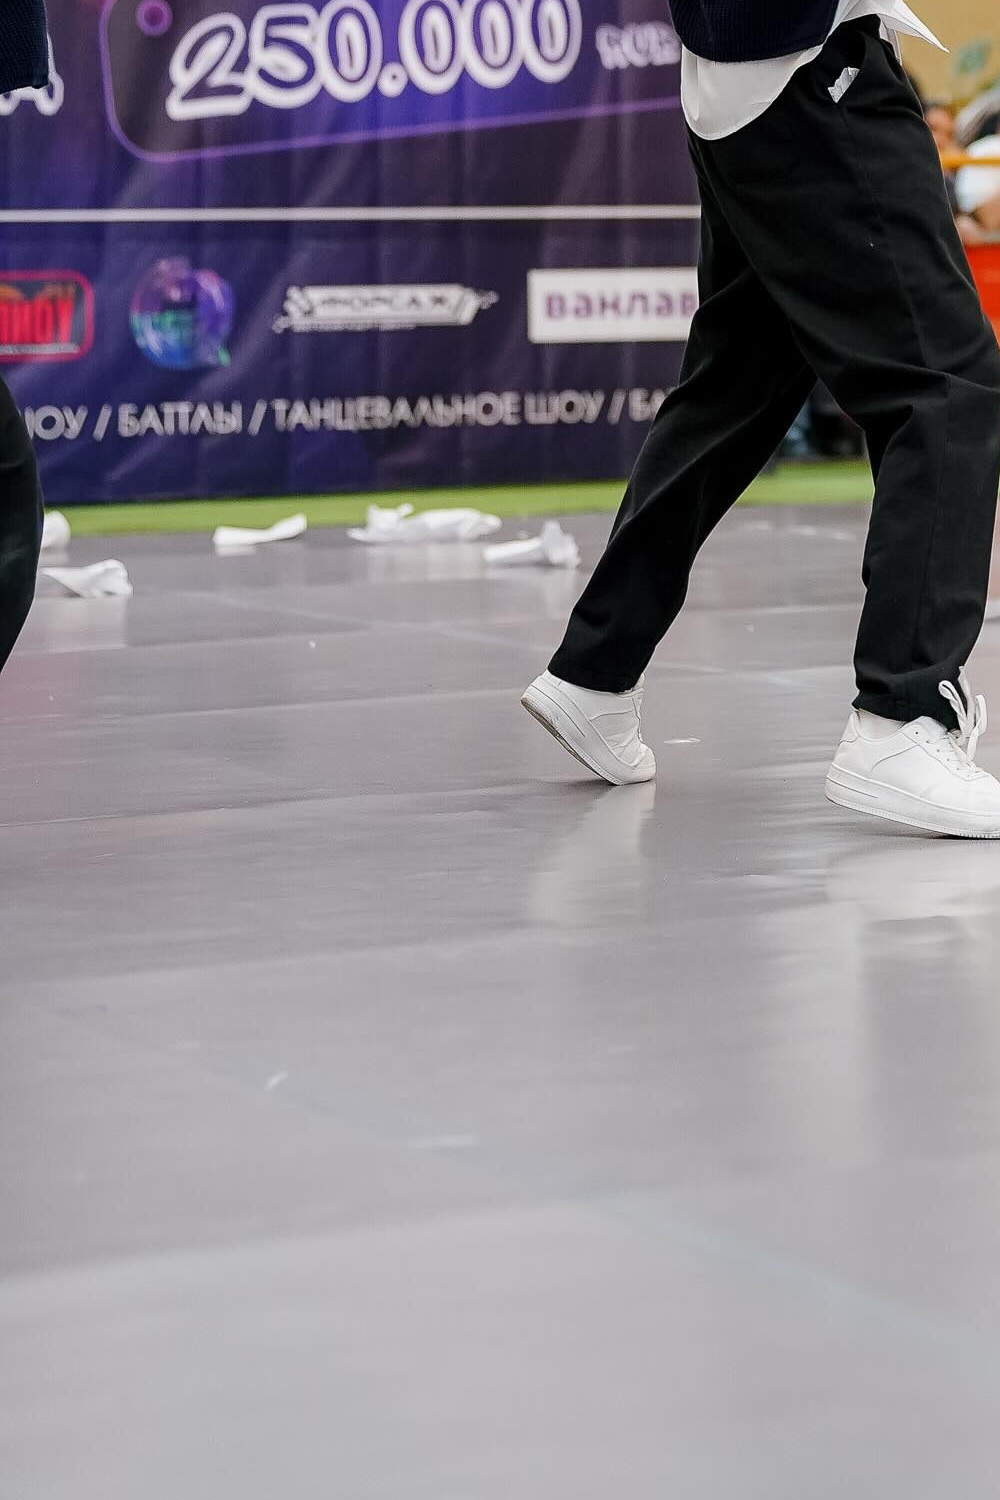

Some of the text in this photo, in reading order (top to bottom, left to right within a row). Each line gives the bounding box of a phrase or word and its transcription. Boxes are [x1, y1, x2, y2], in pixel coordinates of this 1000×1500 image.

[118, 401, 243, 438] БАТТЛЫ
[271, 390, 522, 433] ТАНЦЕВАЛЬНОЕ
[524, 388, 604, 425] ШОУ
